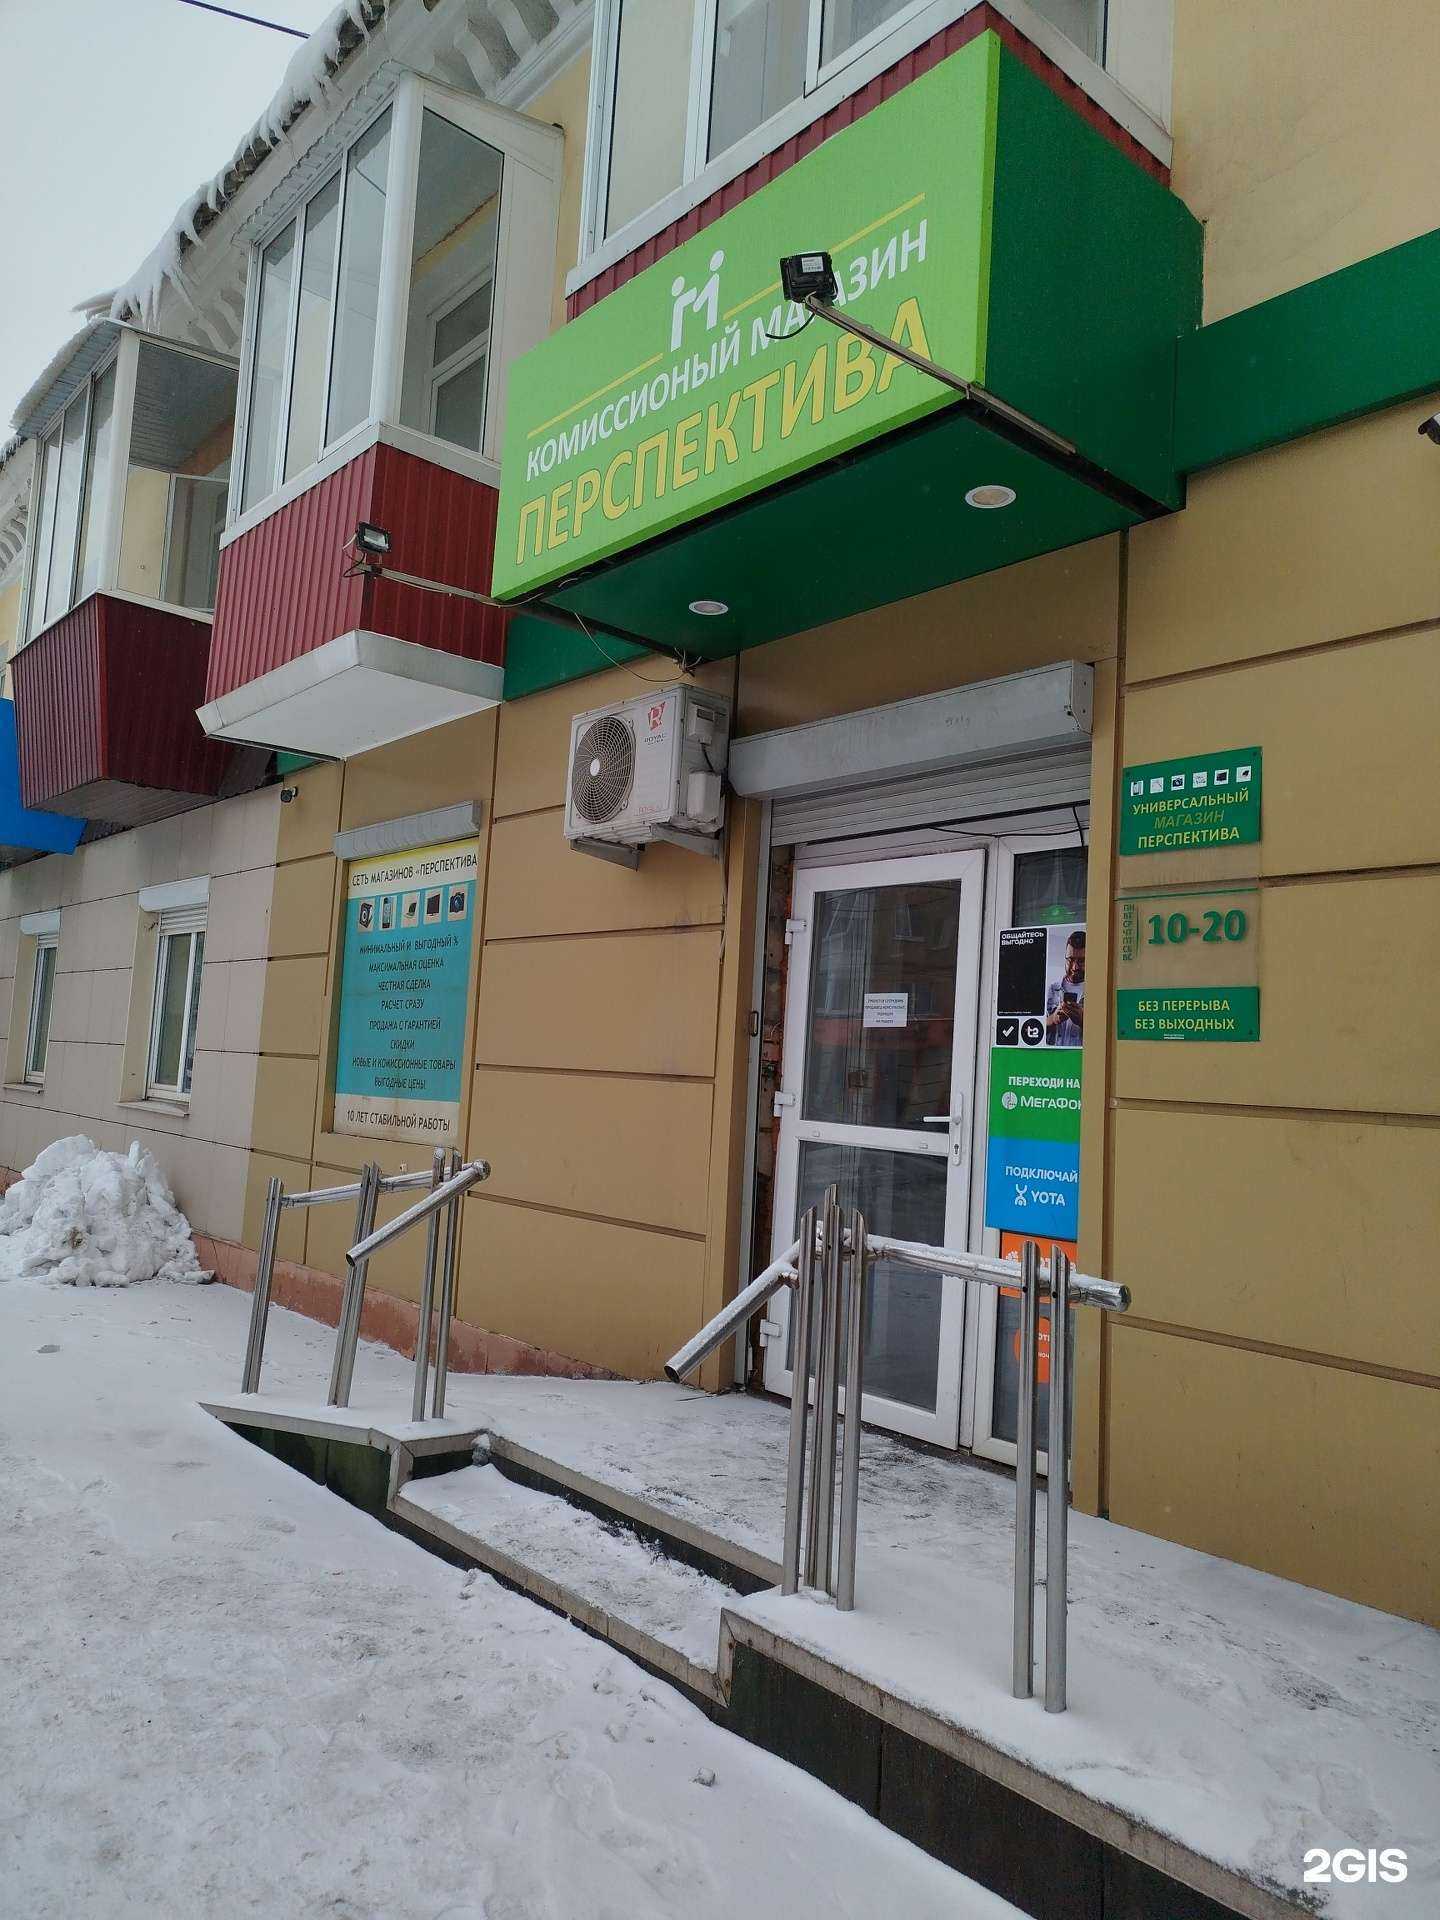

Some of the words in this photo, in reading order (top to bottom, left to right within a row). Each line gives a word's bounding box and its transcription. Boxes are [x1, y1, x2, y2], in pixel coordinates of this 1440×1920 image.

[525, 319, 740, 482] КОМИССИОНЫЙ
[515, 296, 934, 566] ПЕРСПЕКТИВА
[1132, 787, 1249, 815] УНИВЕРСАЛЬНЫЙ
[1154, 809, 1225, 829] МАГАЗИН
[1137, 826, 1240, 849] ПЕРСПЕКТИВА
[352, 872, 369, 887] СЕТЬ
[371, 866, 414, 884] МАГАЗИНОВ
[1148, 909, 1247, 944] 10-20
[415, 934, 453, 951] ВЫГОДНЫЙ
[1001, 930, 1044, 940] ОБЩАЙТЕСЬ
[1001, 939, 1034, 947] ВЫГОДНО
[368, 960, 417, 973] МАКСИМАЛЬНАЯ
[418, 958, 445, 972] ОЦЕНКА
[378, 980, 404, 991] ЧЕСТНАЯ
[406, 979, 431, 991] СДЕЛКА
[381, 999, 404, 1010] РАСЧЕТ
[405, 998, 425, 1009] СРАЗУ
[1138, 1000, 1159, 1012] БЕЗ
[1162, 999, 1230, 1011] ПЕРЕРЫВА
[369, 1020, 398, 1032] ПРОДАЖА
[403, 1017, 441, 1031] ГАРАНТИЕЙ
[1135, 1018, 1155, 1030] БЕЗ
[1158, 1018, 1235, 1031] ВЫХОДНЫХ
[390, 1040, 415, 1051] СКИДКИ
[352, 1058, 373, 1068] НОВЫЕ
[377, 1058, 429, 1070] КОМИССИОННЫЕ
[429, 1060, 456, 1070] ТОВАРЫ
[374, 1076, 407, 1089] ВЫГОДНЫЕ
[408, 1079, 426, 1091] ЦЕНЫ
[1008, 1076, 1064, 1089] ПЕРЕХОДИ
[1066, 1078, 1081, 1089] НА
[347, 1110, 355, 1121] 10
[355, 1112, 368, 1123] ЛЕТ
[369, 1112, 416, 1128] СТАБИЛЬНОЙ
[418, 1117, 450, 1131] РАБОТЫ
[1005, 1165, 1078, 1183] ПОДКЛЮЧАЙ
[1031, 1190, 1066, 1207] YOTA
